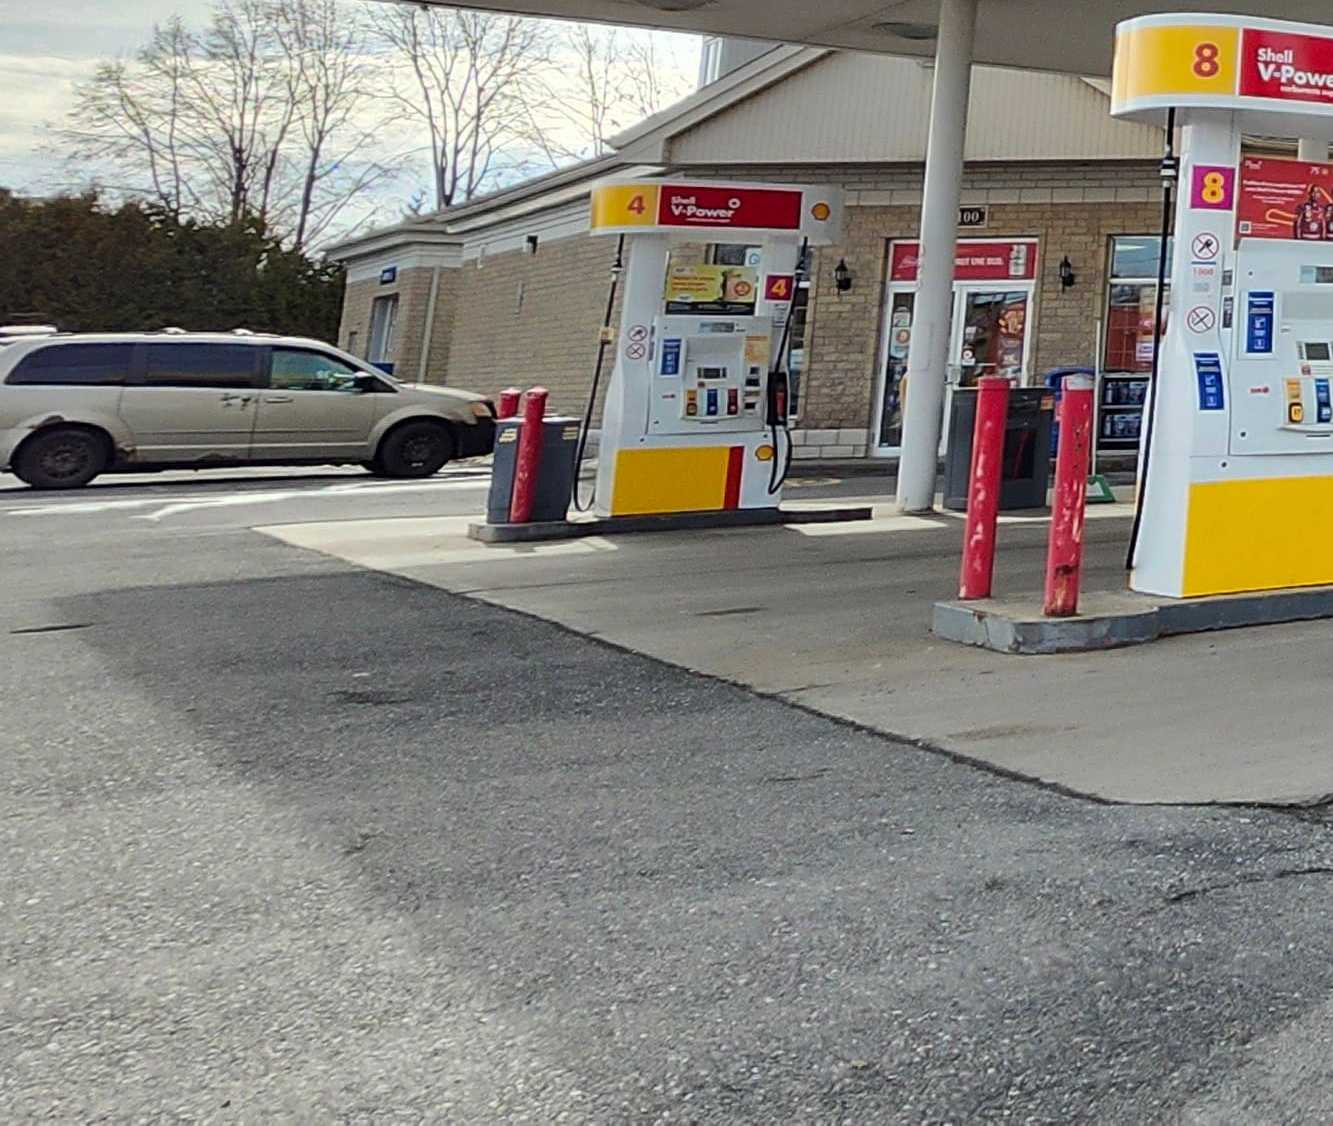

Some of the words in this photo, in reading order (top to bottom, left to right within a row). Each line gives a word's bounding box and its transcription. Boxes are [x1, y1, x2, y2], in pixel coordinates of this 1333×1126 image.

[1193, 41, 1220, 79] 8
[1257, 47, 1294, 64] Shell
[1201, 171, 1225, 204] 8
[626, 194, 646, 215] 4
[670, 195, 697, 205] Shell
[670, 204, 736, 218] V-Power
[771, 278, 788, 297] 4
